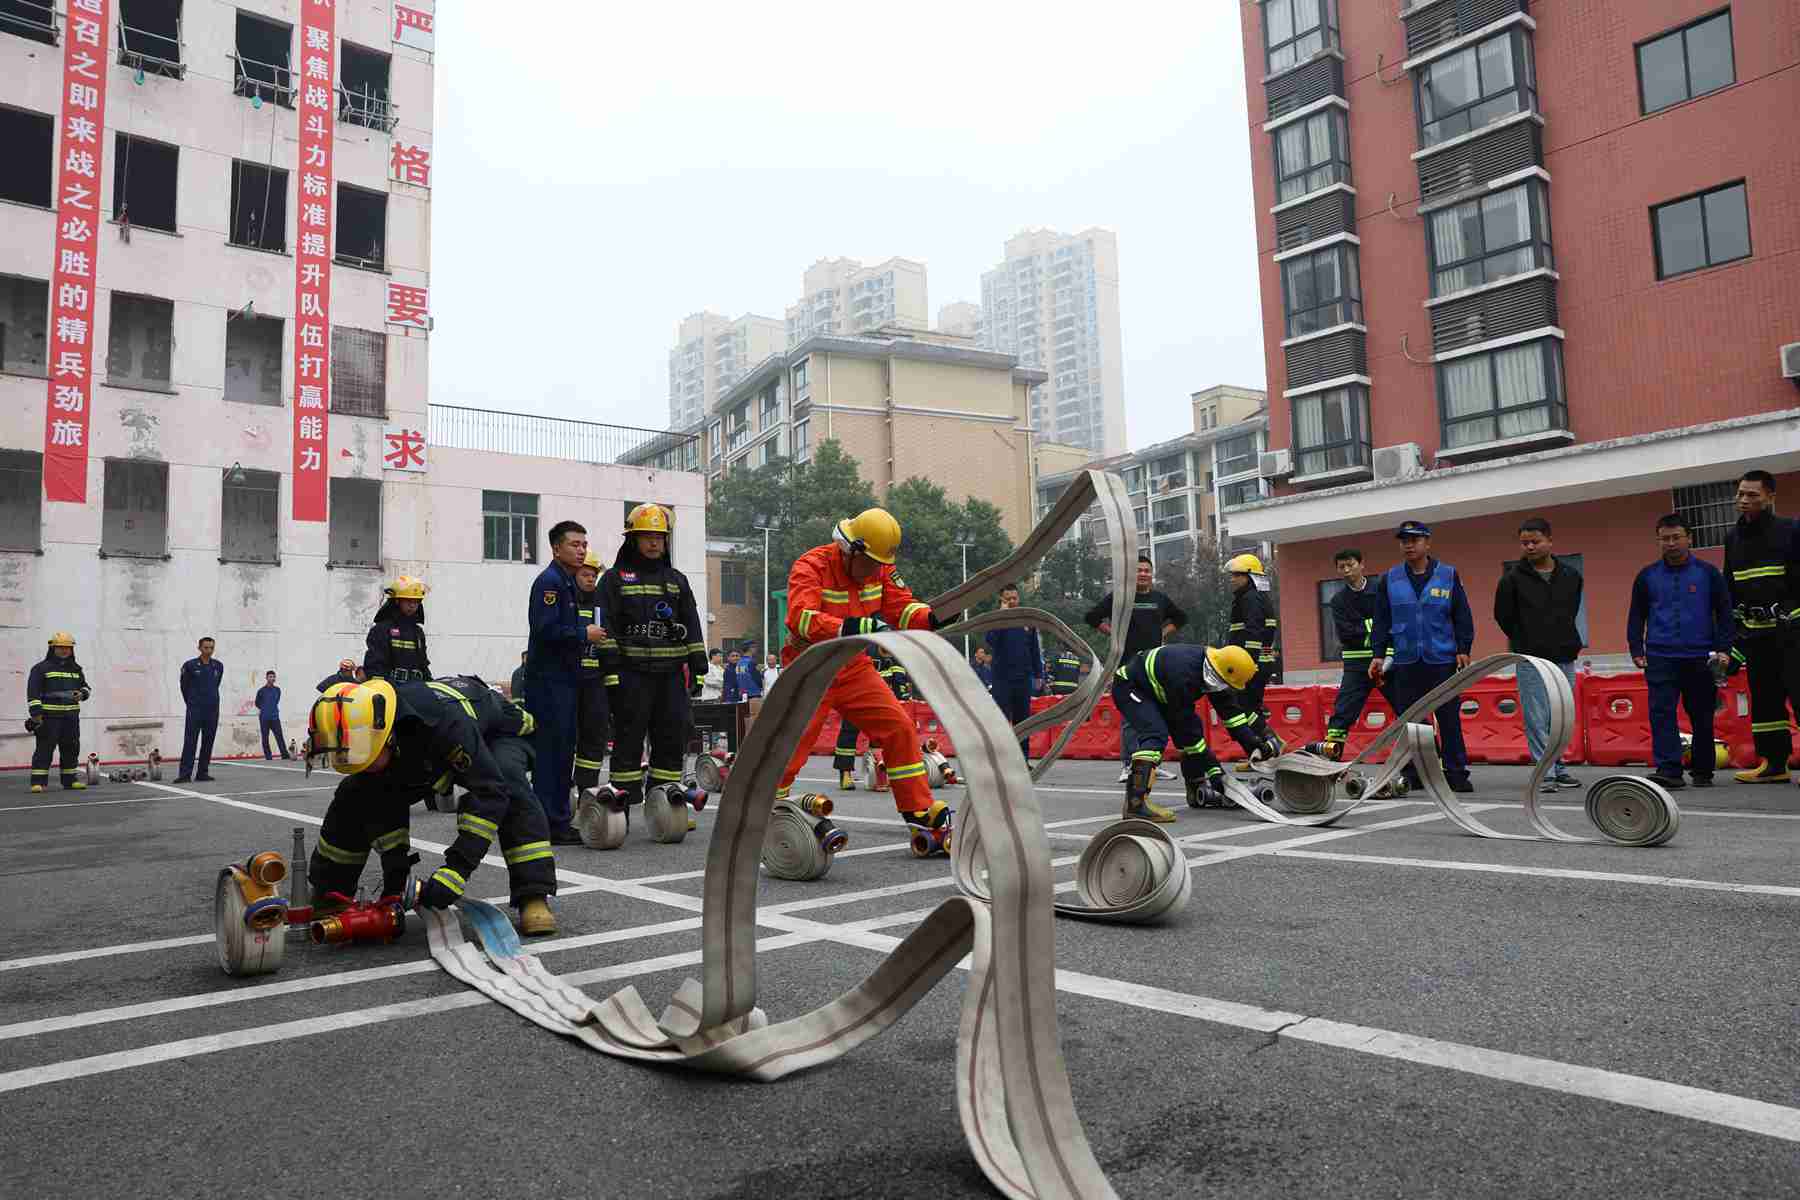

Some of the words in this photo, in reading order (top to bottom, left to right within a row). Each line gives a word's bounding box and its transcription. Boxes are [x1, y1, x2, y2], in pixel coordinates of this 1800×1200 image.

[299, 25, 330, 471] 聚焦战斗力标准提升队伍打赢能力
